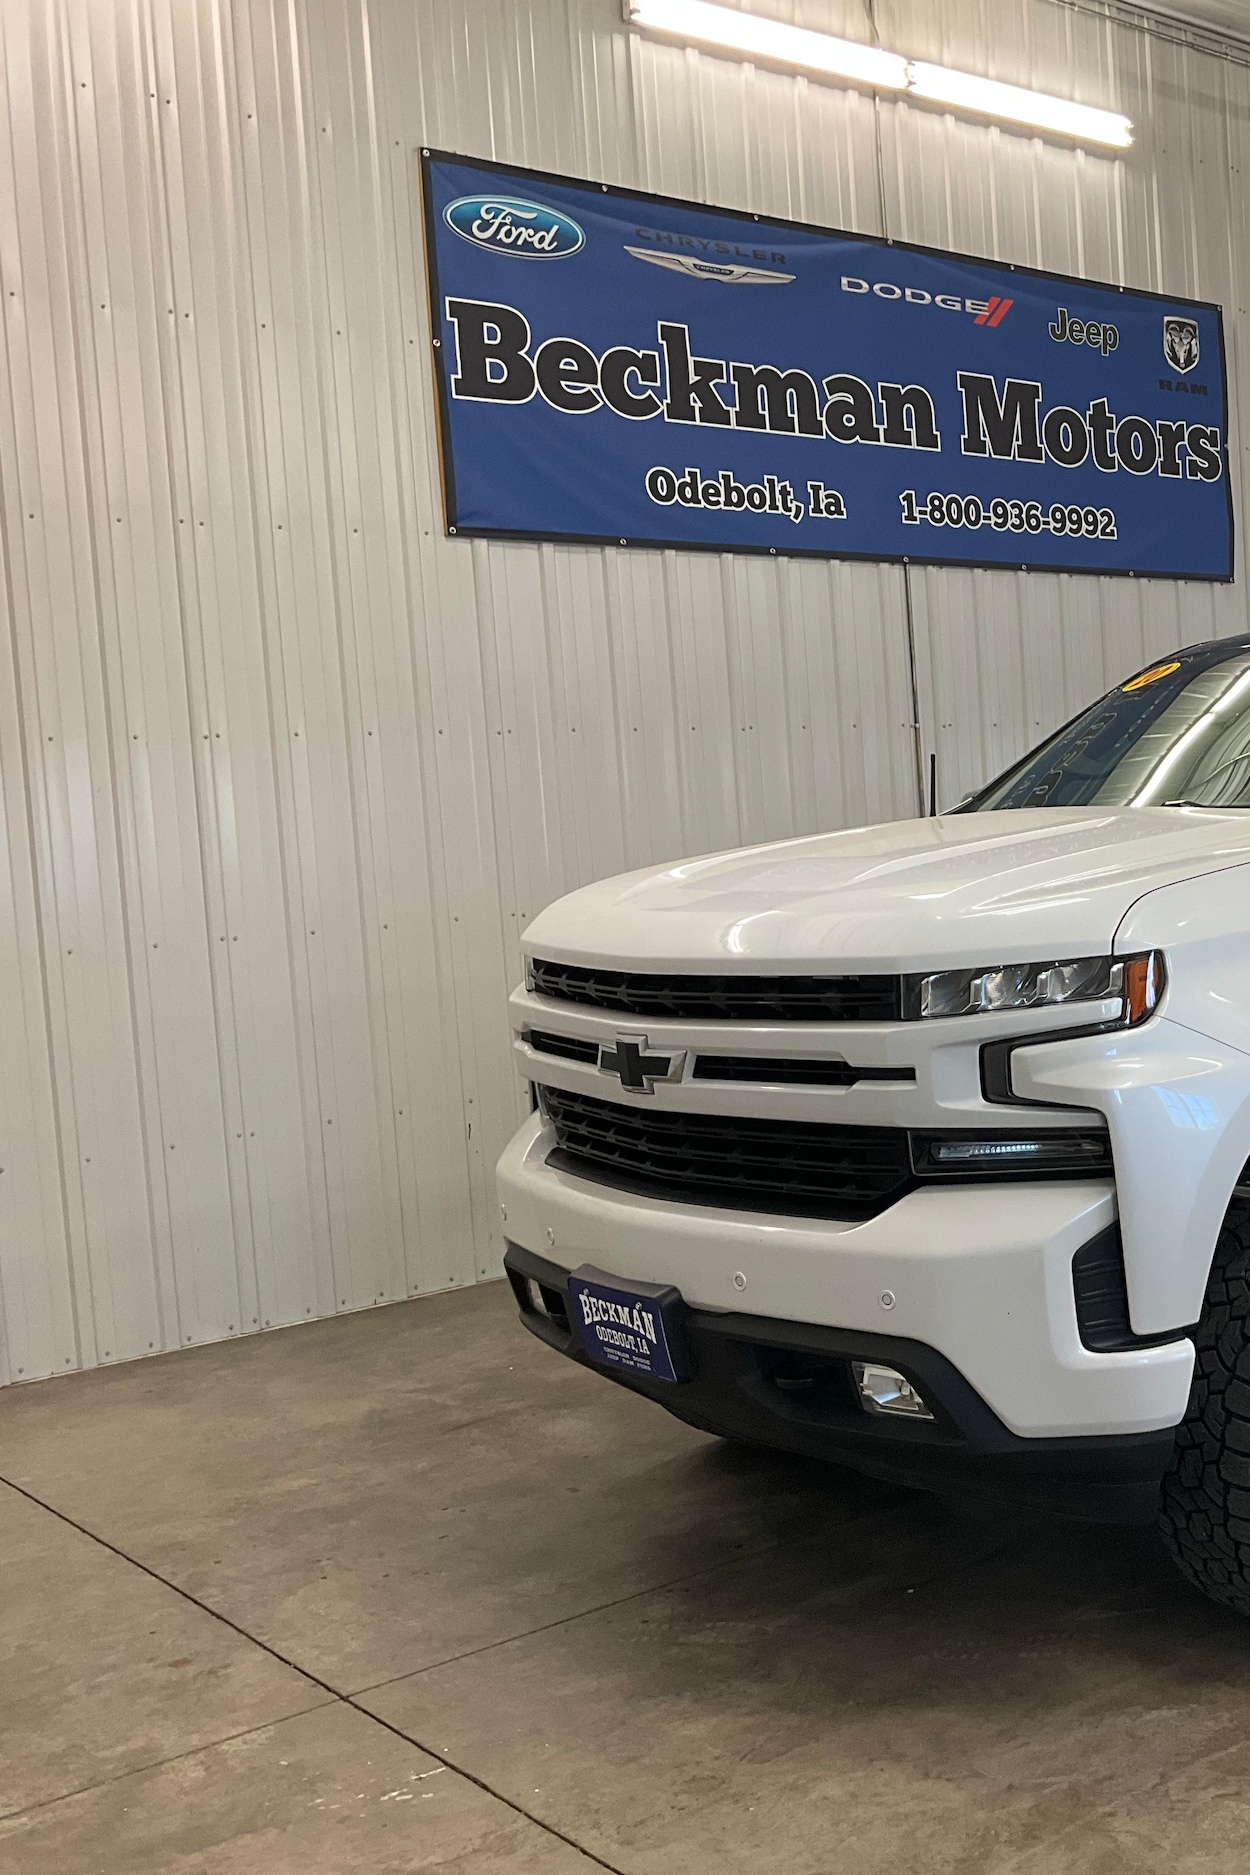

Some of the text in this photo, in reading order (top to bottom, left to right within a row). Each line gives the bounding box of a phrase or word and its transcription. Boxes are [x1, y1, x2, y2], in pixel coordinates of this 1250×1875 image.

[471, 202, 559, 252] Ford
[634, 226, 788, 266] CHRYSLER
[840, 275, 991, 316] DODGE
[1048, 307, 1120, 356] Jeep
[445, 295, 1222, 483] Beckman Motors
[1158, 377, 1209, 397] RAM
[645, 465, 848, 524] Odebolt, Ia
[899, 489, 1119, 541] 1-800-936-9992
[578, 1293, 658, 1345] BECKMAN
[595, 1324, 651, 1355] ODEBOLT, IA
